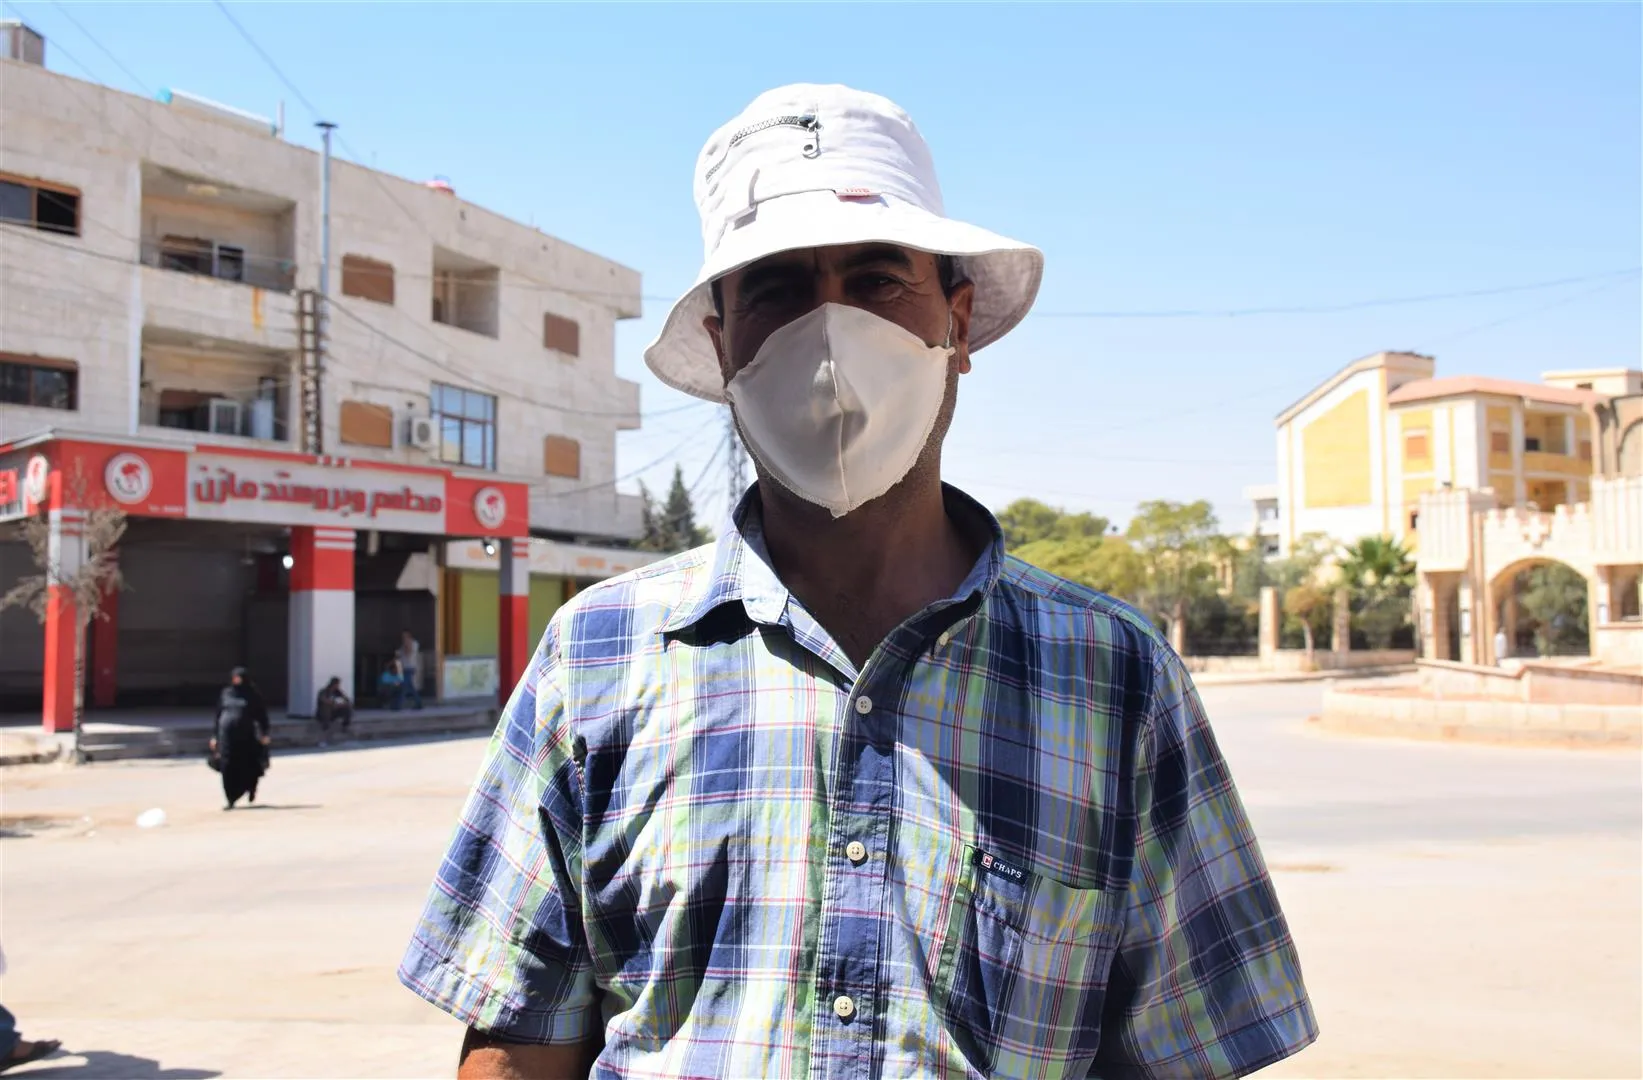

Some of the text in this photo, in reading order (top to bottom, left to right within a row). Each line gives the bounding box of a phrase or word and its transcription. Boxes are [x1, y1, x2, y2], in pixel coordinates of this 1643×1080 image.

[194, 465, 259, 504] مازن
[370, 485, 442, 518] مطعم
[993, 862, 1022, 879] CHAPS
